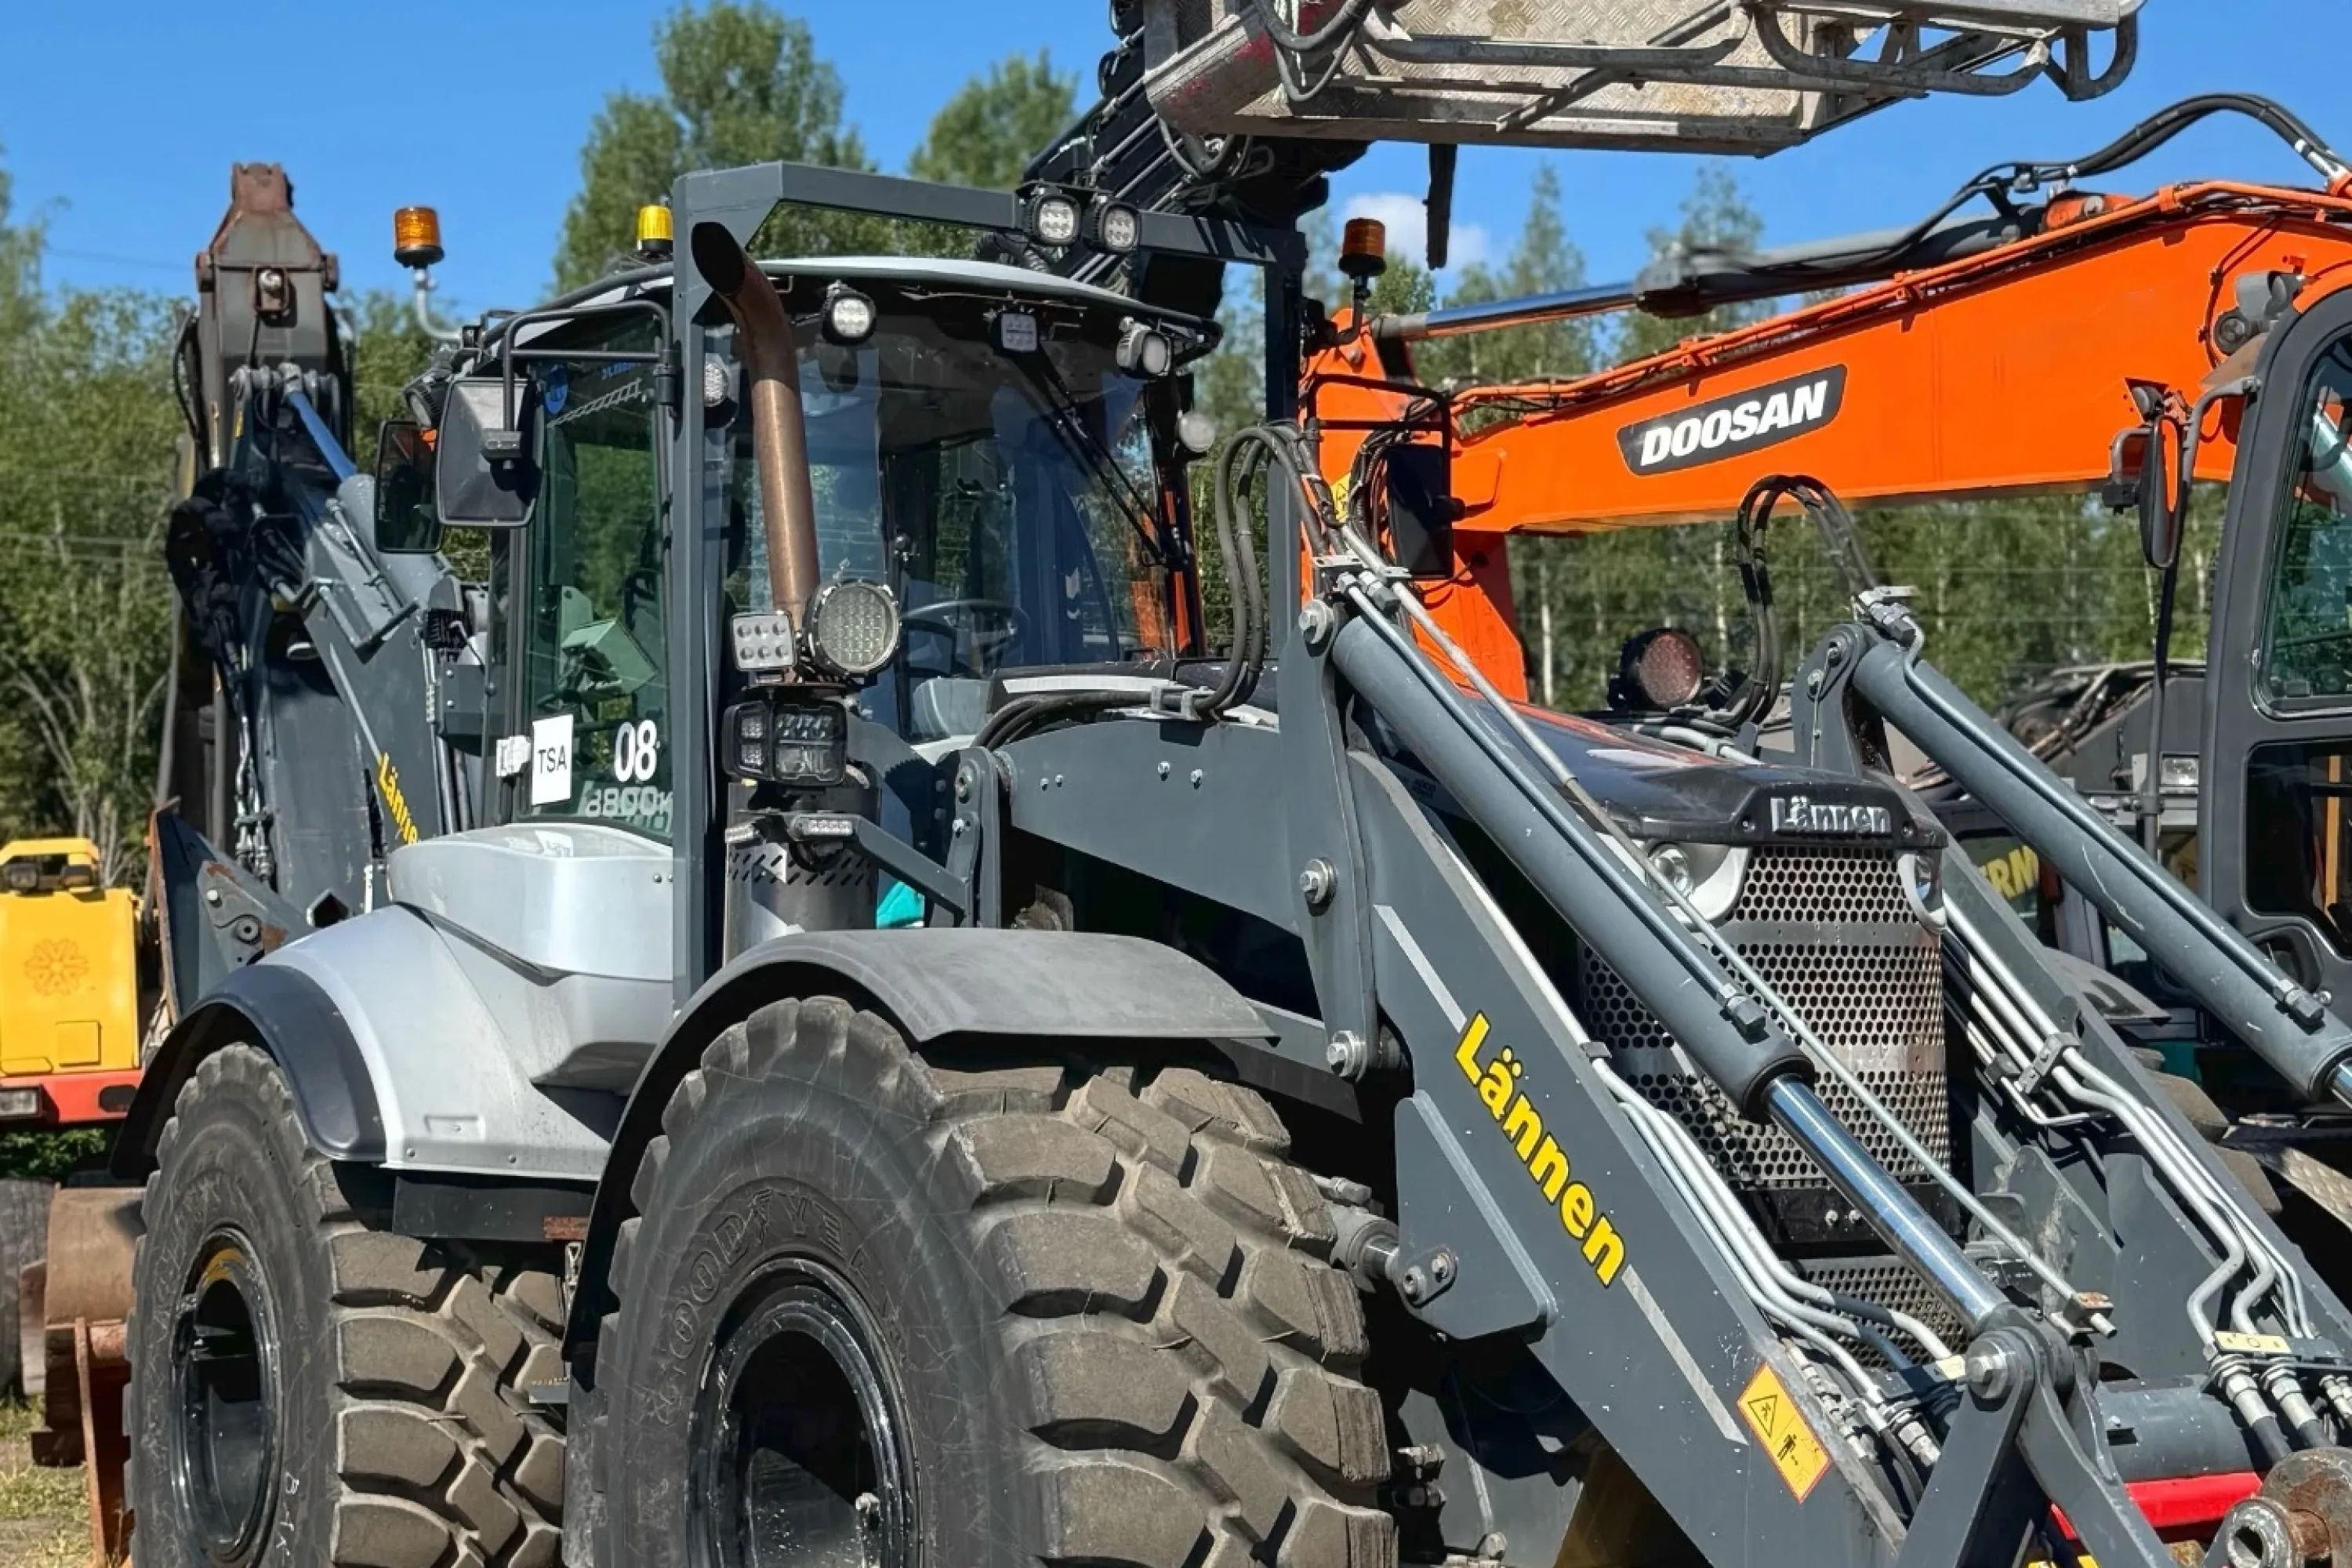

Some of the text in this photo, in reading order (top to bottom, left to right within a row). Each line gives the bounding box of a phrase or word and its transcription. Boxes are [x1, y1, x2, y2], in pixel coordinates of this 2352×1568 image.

[1641, 380, 1828, 466] DOOSAN
[537, 745, 568, 775] TSA
[615, 720, 657, 782] 08
[1770, 795, 1893, 833] Lännen
[1978, 844, 2039, 898] RM
[1454, 1011, 1624, 1287] Lännen
